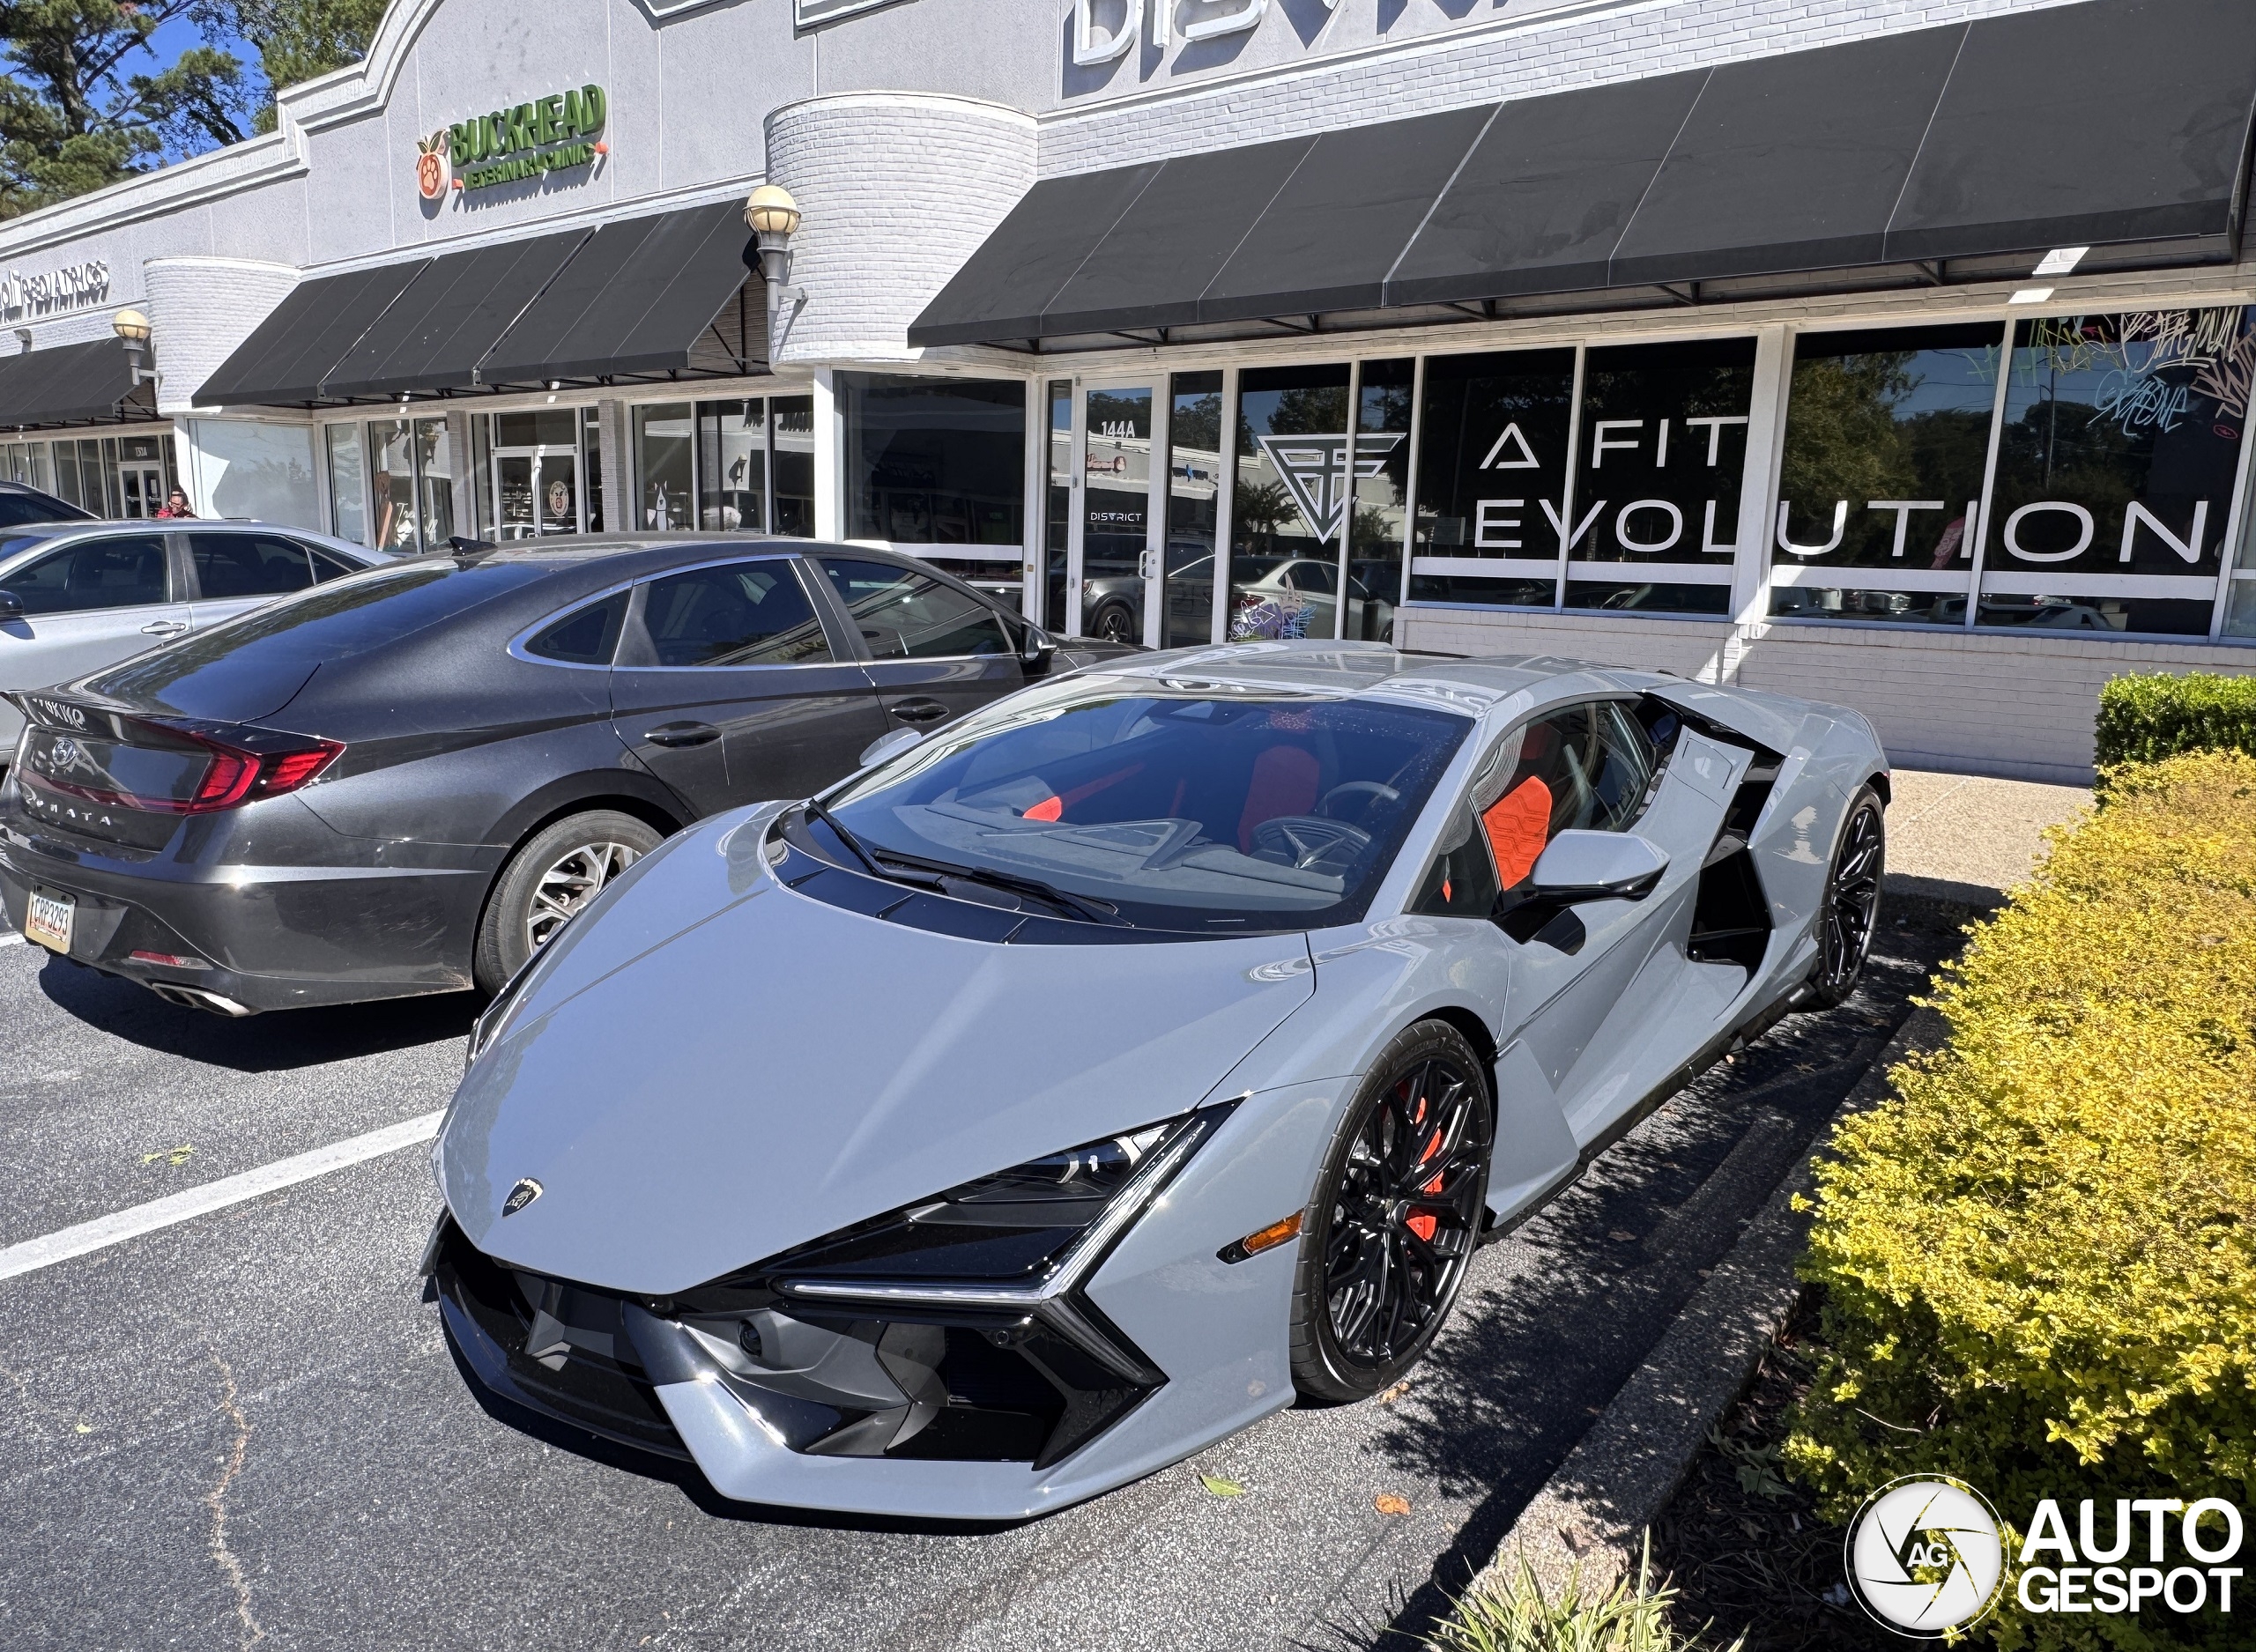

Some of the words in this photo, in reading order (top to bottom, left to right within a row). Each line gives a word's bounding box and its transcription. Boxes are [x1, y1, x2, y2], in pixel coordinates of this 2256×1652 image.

[449, 84, 606, 167] BUCKHEAD
[545, 141, 598, 172] CLINIC
[1101, 420, 1135, 439] 144A
[1592, 415, 1749, 469] FIT
[1090, 512, 1142, 522] DISTRICT
[1474, 499, 2208, 564] EVOLUTION
